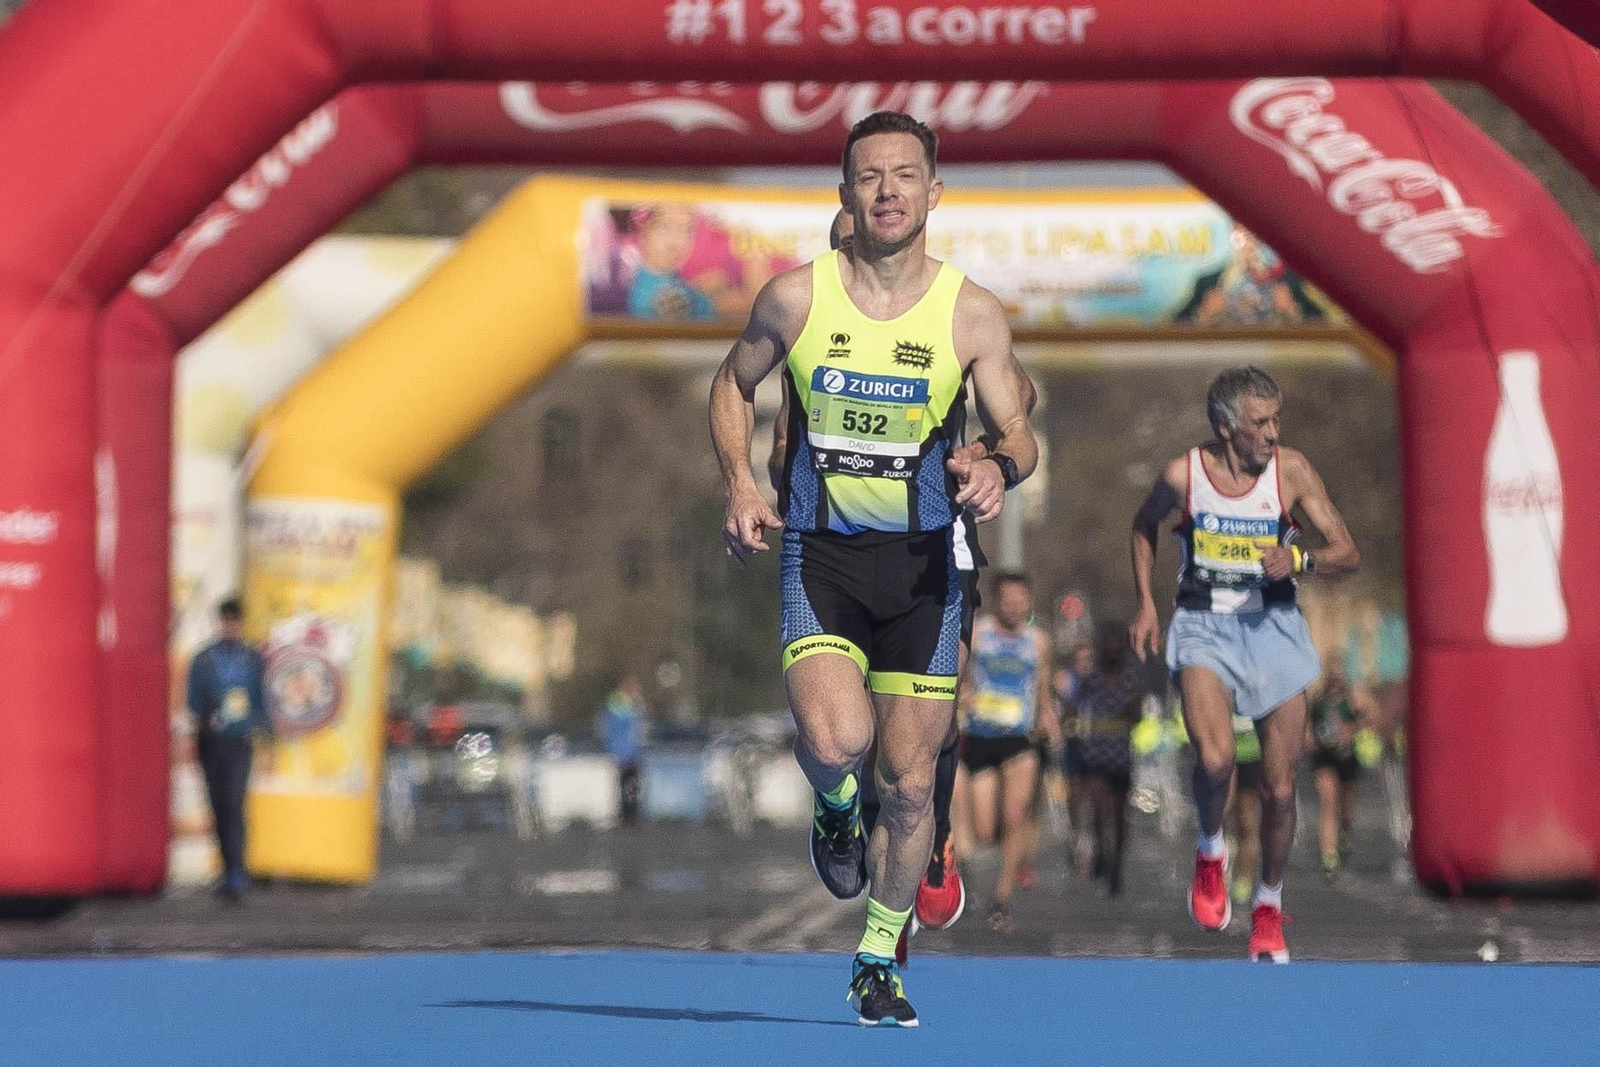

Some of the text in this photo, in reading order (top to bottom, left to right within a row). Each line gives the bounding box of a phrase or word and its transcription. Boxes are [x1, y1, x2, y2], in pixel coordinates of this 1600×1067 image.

[849, 378, 914, 398] ZURICH
[842, 409, 888, 435] 532
[848, 440, 875, 451] DAVID
[882, 470, 912, 478] ZURICH
[1220, 519, 1269, 535] ZURICH
